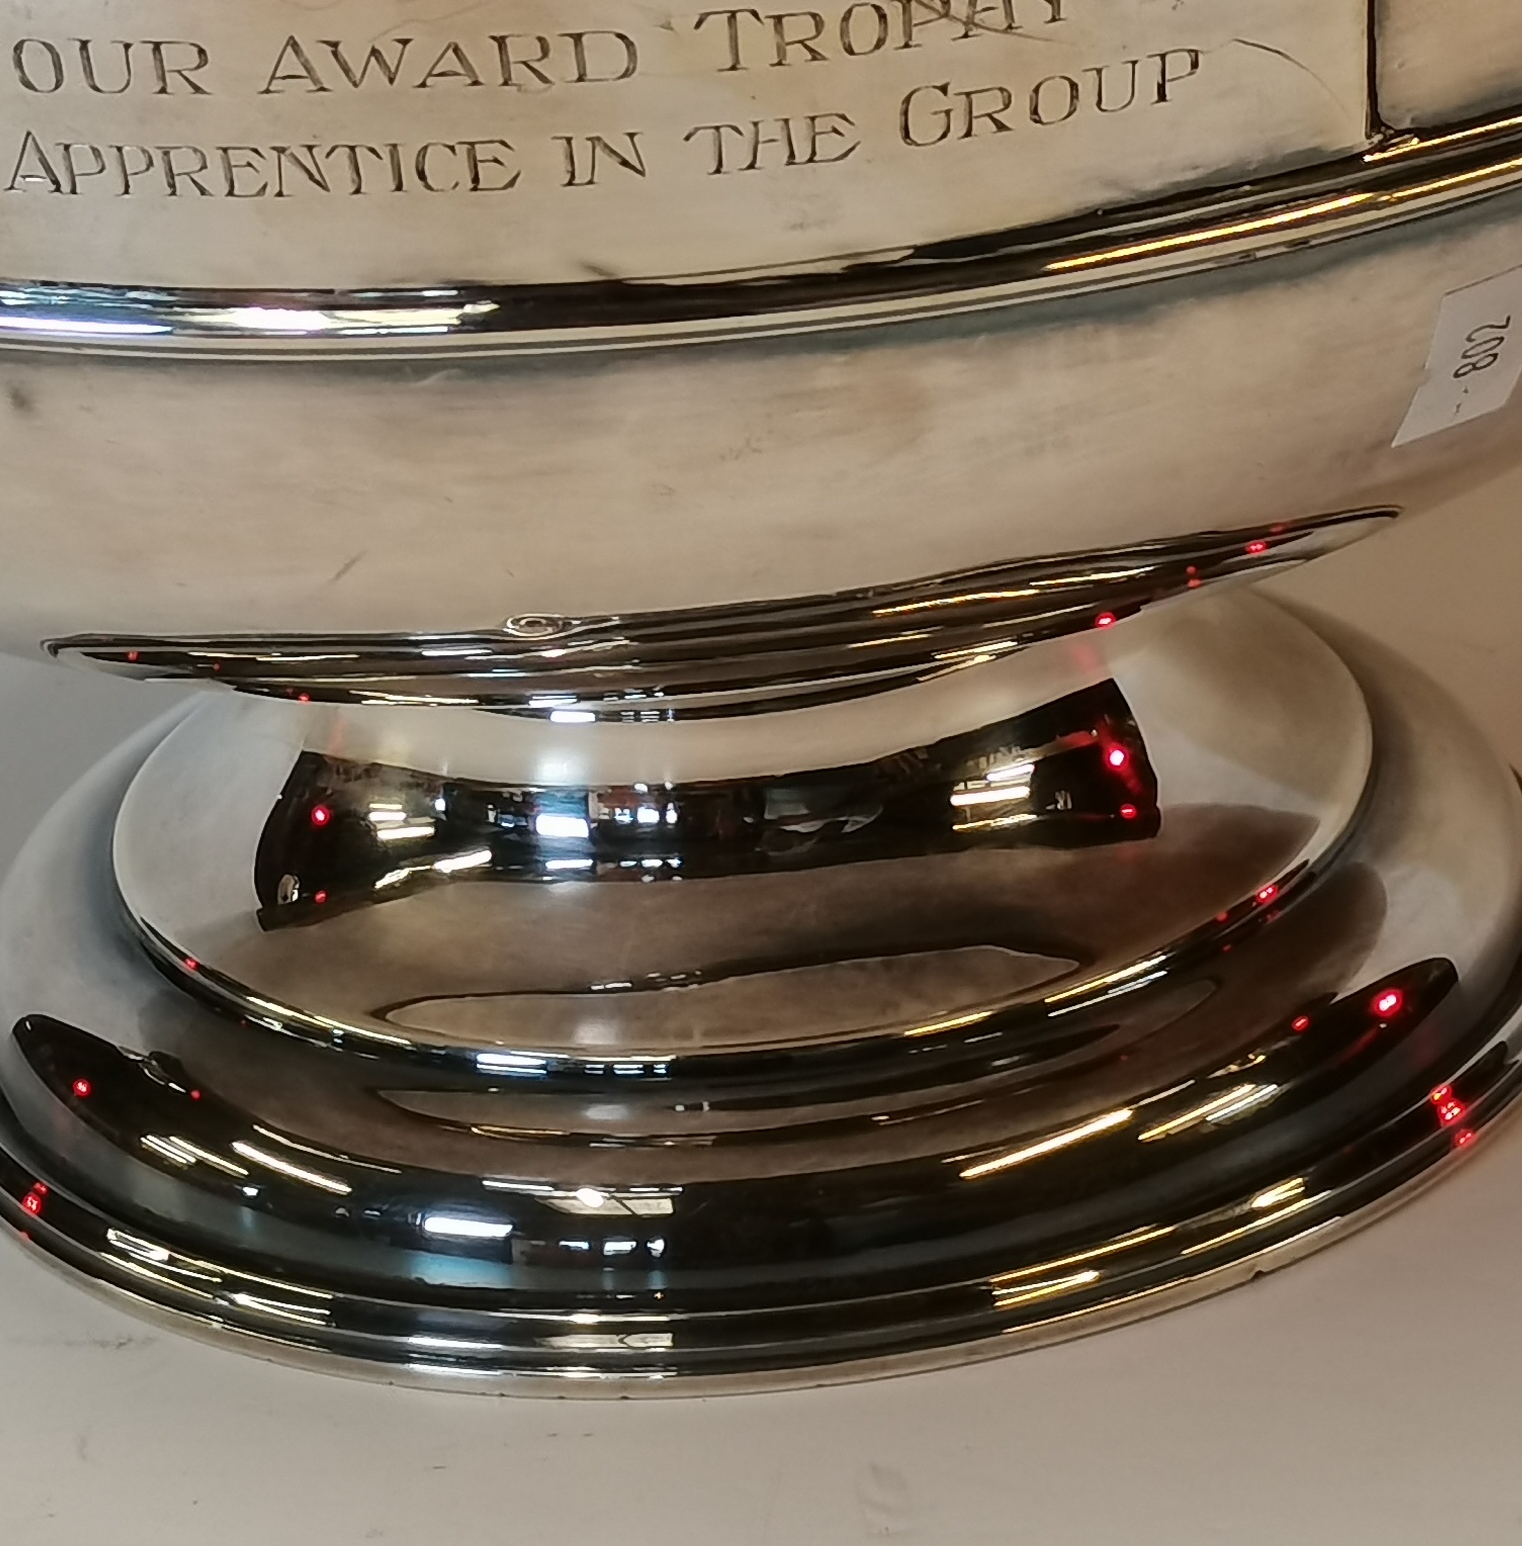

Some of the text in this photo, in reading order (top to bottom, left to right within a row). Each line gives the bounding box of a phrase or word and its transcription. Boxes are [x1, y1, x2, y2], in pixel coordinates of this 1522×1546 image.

[258, 29, 640, 96] AWARD
[3, 130, 521, 199] APPRENTICE
[552, 131, 647, 188] IN
[682, 111, 861, 176] THE
[898, 48, 1201, 149] GROUP
[1452, 315, 1512, 379] 802
